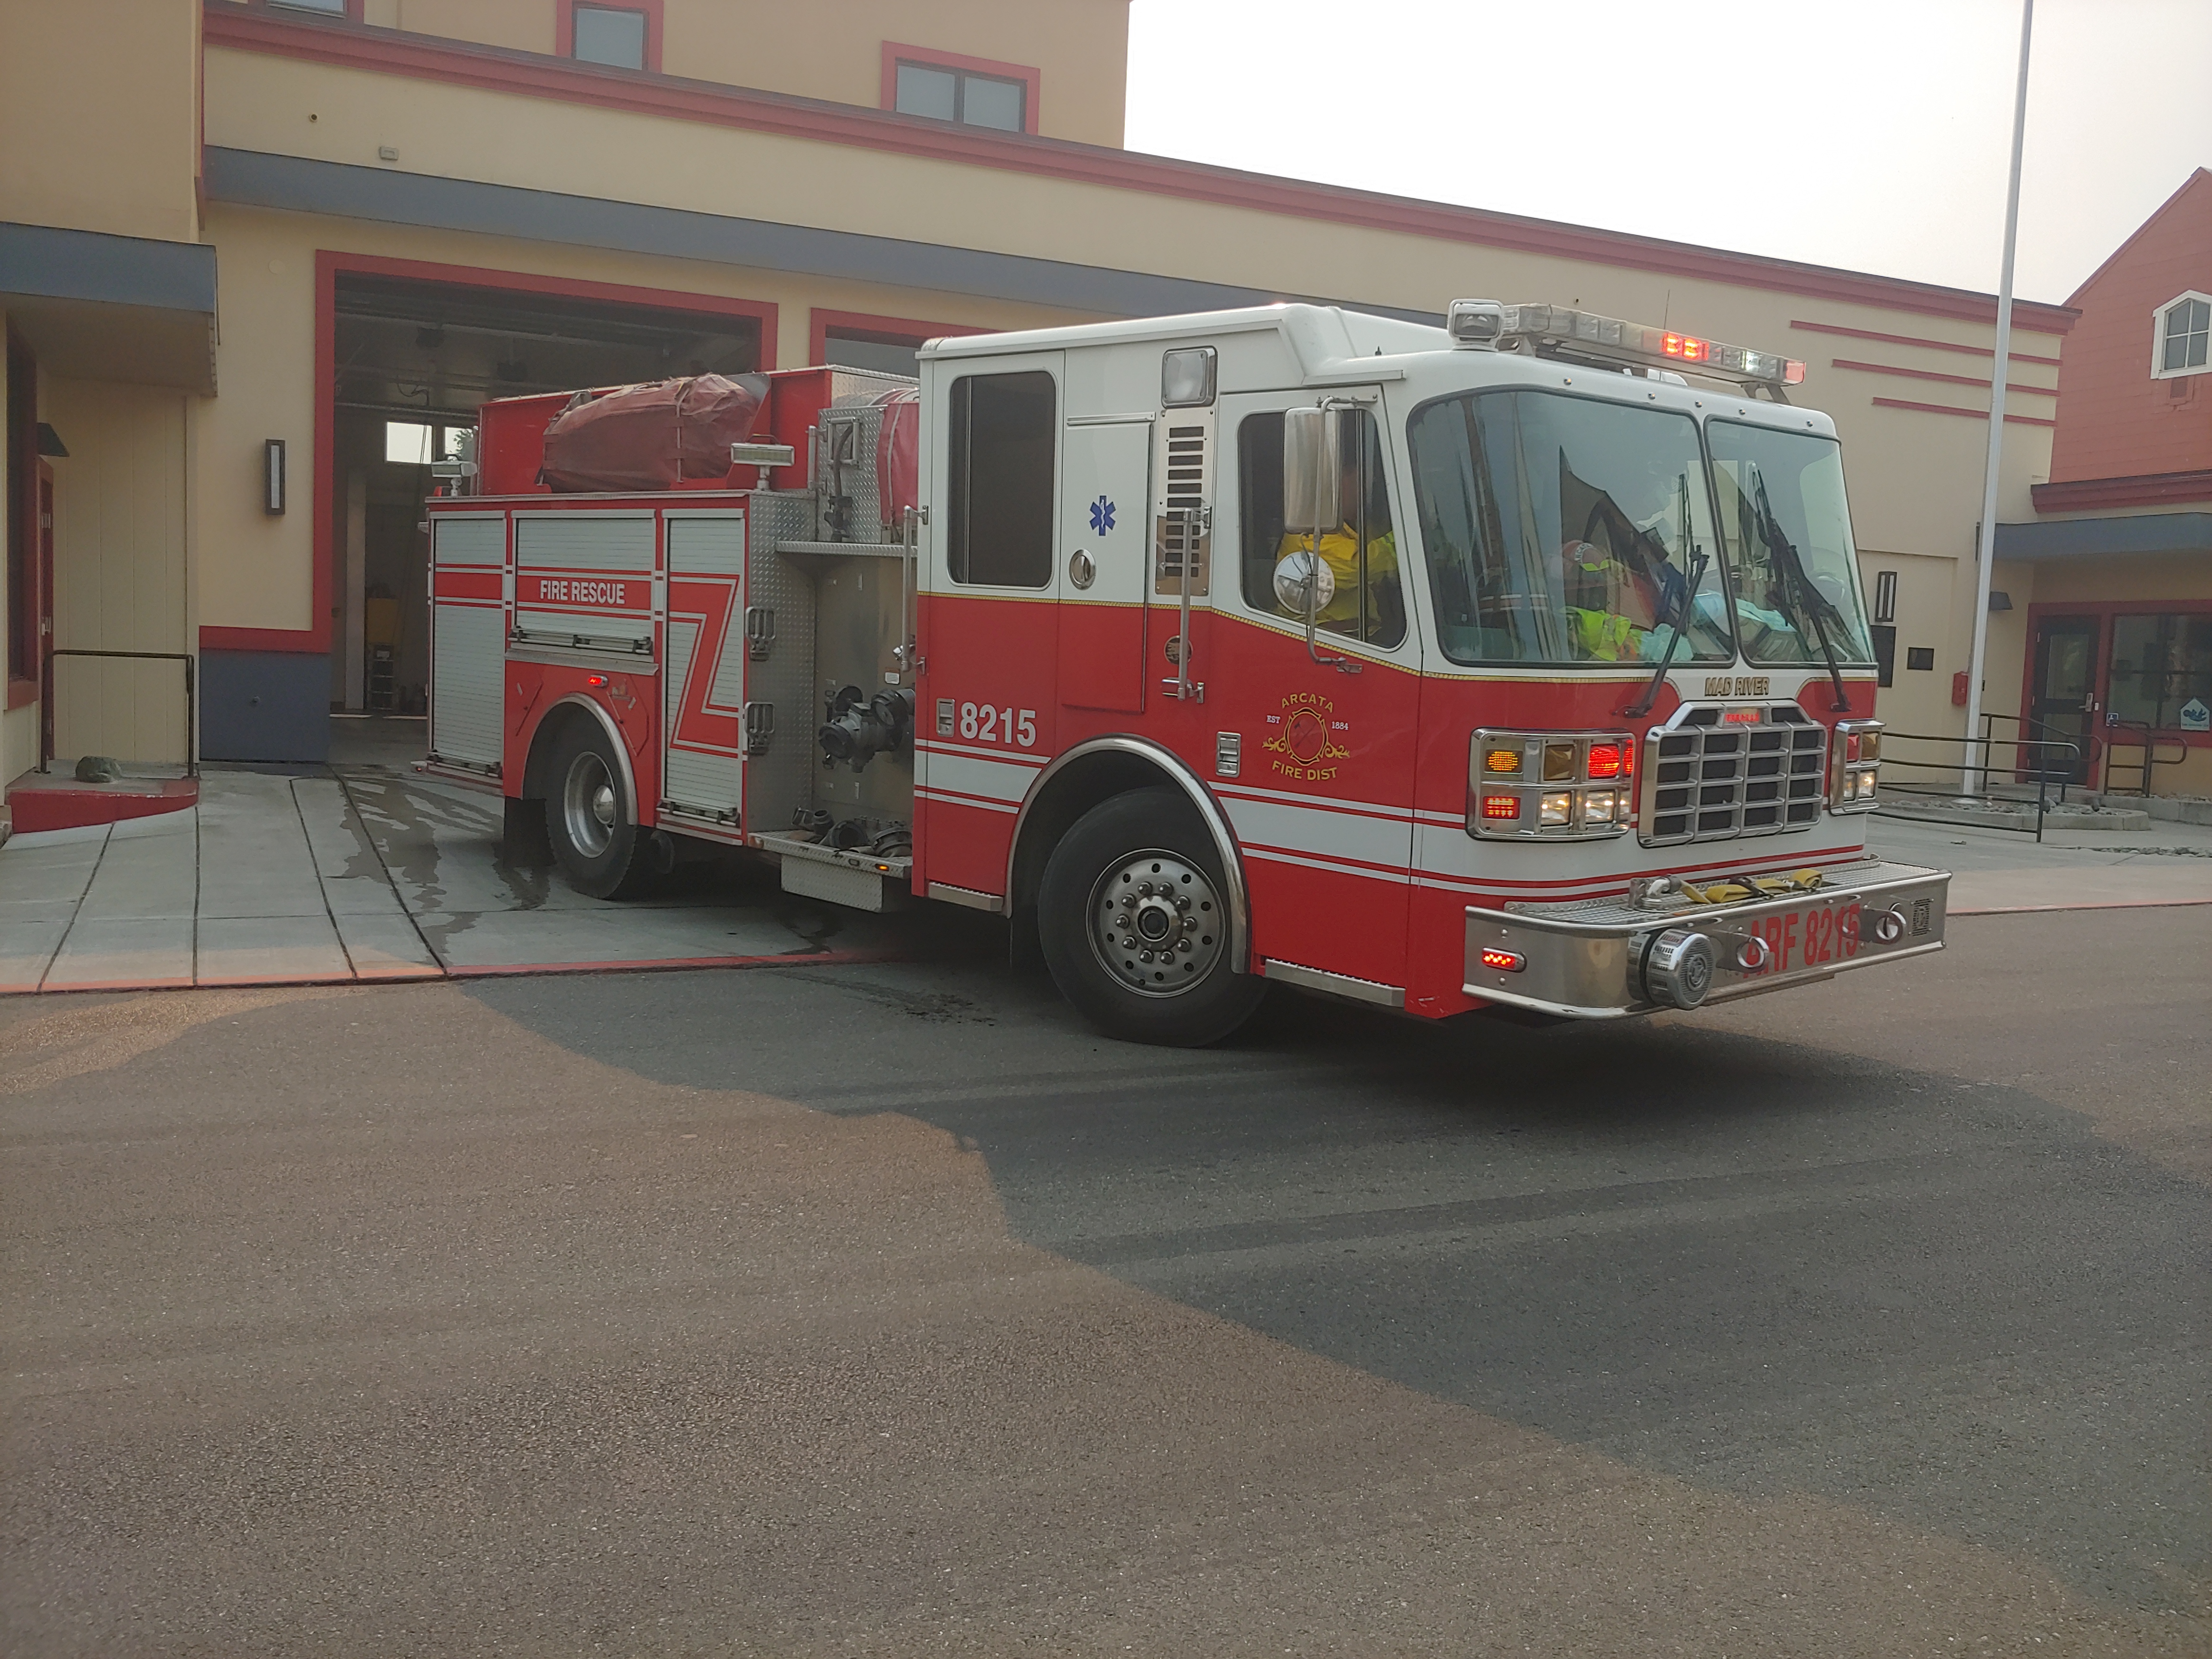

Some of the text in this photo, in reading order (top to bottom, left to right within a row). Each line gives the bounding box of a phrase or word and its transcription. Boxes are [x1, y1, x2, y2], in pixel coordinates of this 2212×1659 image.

[540, 580, 625, 604] FIRE RESCUE
[1705, 677, 1770, 696] MAD RIVER
[1281, 692, 1333, 713] ARCATA
[960, 702, 1036, 747] 8215
[1266, 715, 1281, 724] EST
[1331, 721, 1349, 730] 1884
[1272, 760, 1337, 781] FIRE DIST
[1805, 903, 1860, 966] 8215
